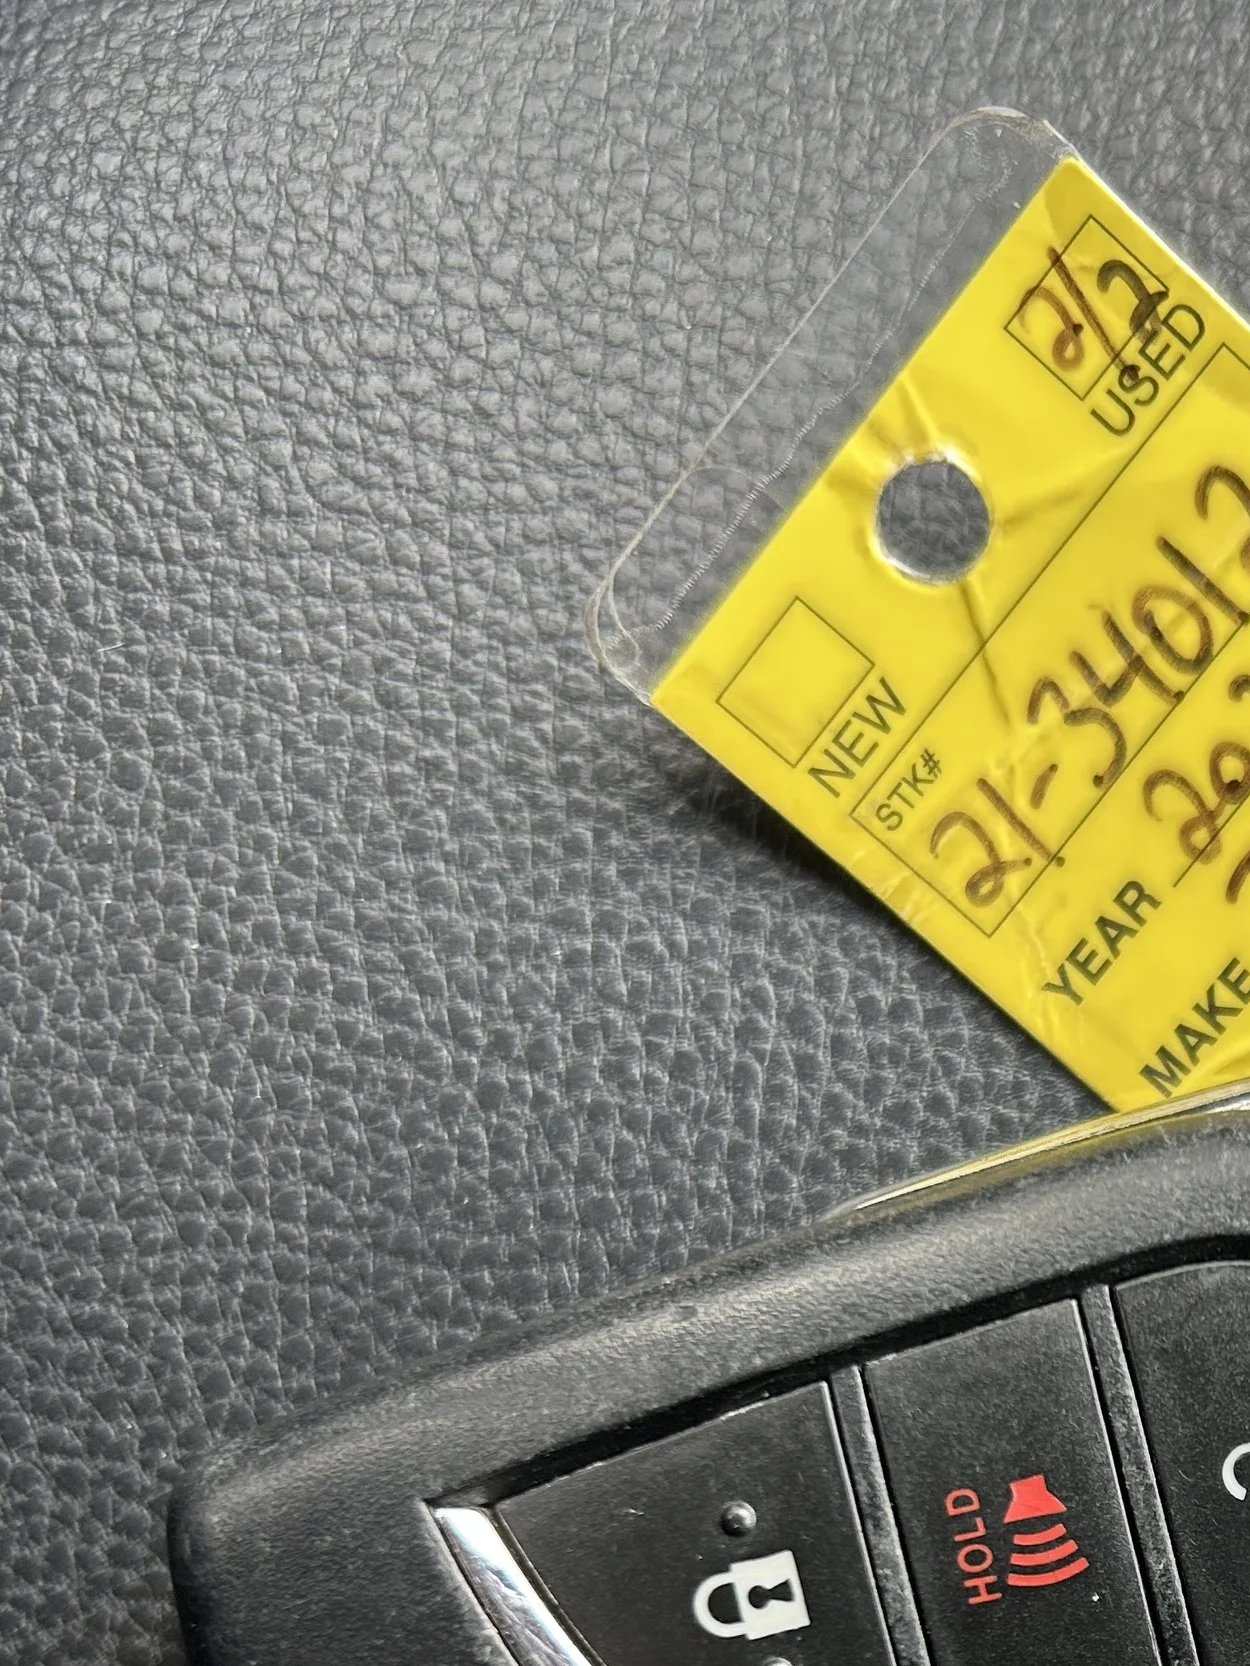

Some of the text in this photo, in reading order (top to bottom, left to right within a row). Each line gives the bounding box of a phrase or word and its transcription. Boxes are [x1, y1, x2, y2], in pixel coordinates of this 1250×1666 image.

[1090, 303, 1206, 437] USED
[807, 676, 907, 799] NEW
[875, 748, 942, 832] STK#
[1042, 880, 1162, 1006] YEAR
[944, 1488, 1003, 1605] HOLD
